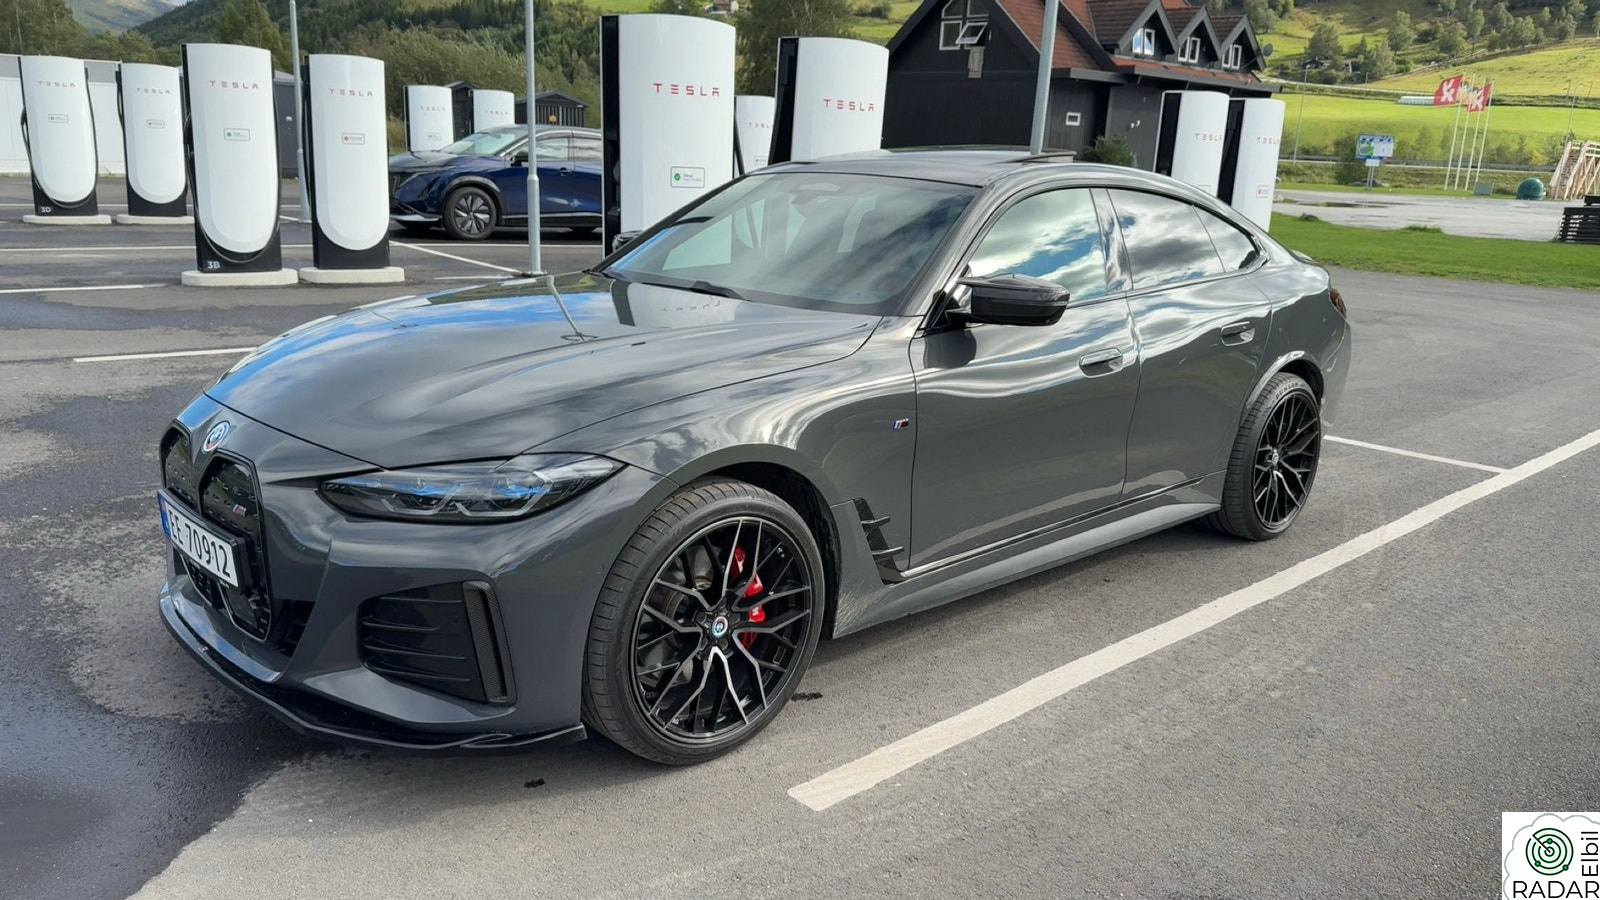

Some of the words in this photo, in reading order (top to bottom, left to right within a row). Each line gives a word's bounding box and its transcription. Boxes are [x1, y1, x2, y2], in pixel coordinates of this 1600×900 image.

[37, 80, 76, 88] TESLA
[209, 79, 259, 90] TESLA
[653, 82, 720, 97] TESLA
[328, 87, 374, 97] TESLA
[823, 98, 875, 112] TESLA
[207, 261, 221, 269] 3B
[168, 509, 184, 546] EE
[185, 522, 231, 578] 70912
